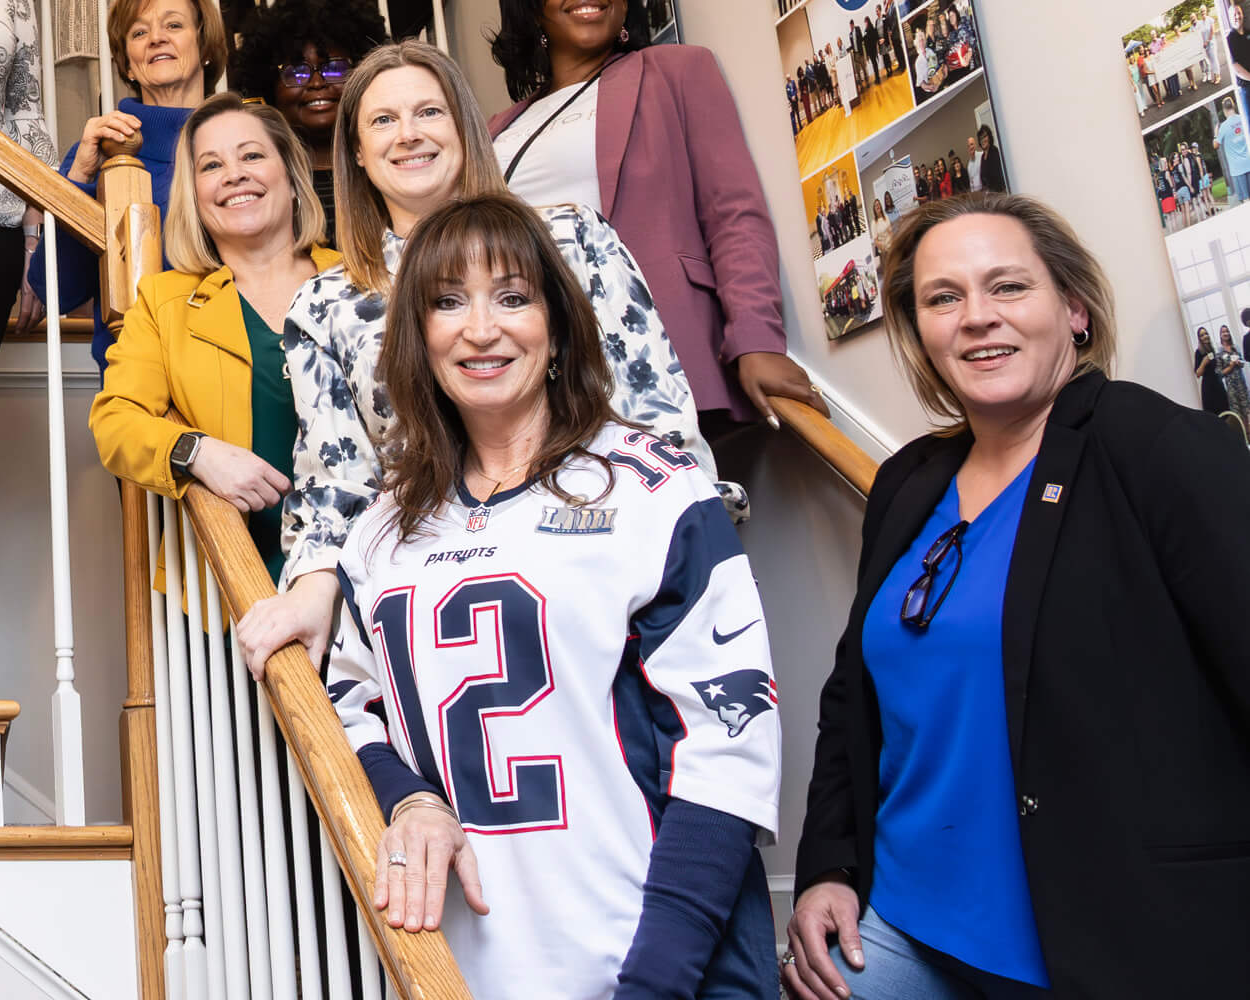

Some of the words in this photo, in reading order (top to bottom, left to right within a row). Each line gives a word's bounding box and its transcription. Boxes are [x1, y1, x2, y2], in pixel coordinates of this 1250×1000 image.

[606, 431, 698, 493] 12
[467, 516, 485, 530] NFL
[424, 546, 498, 566] PATRIOTS
[371, 572, 568, 835] 12
